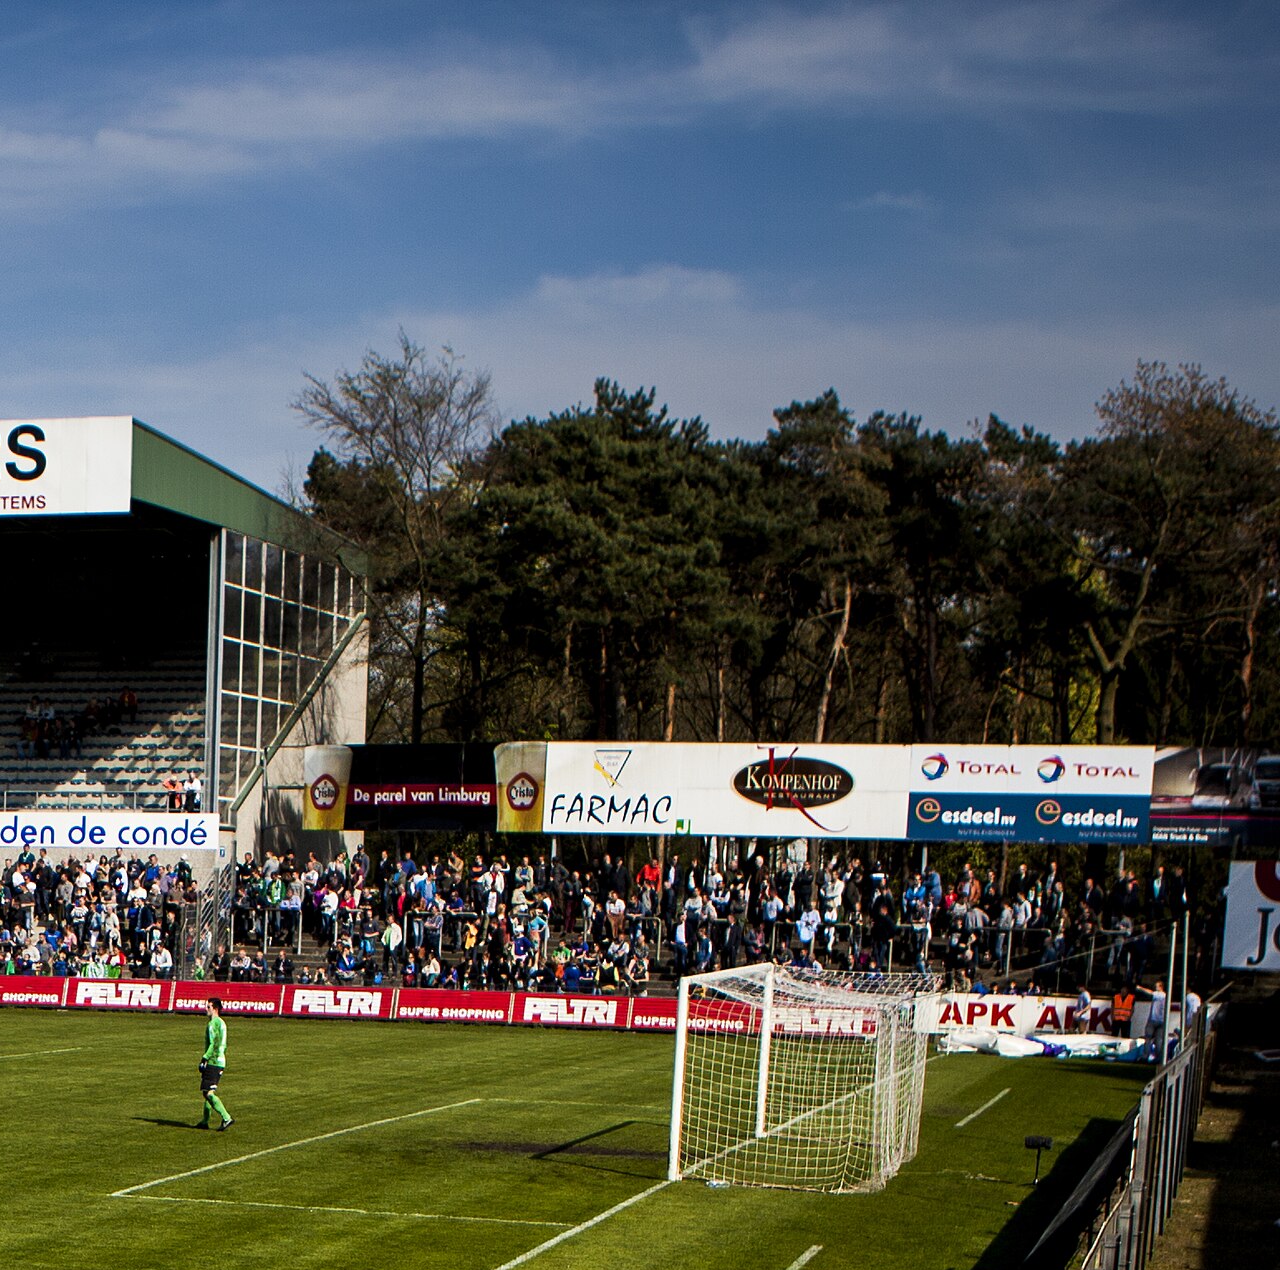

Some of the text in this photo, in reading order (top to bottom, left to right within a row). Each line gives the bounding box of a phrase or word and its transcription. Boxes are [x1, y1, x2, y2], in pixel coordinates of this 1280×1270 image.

[745, 765, 842, 790] KOMPENHOF
[956, 761, 1022, 775] TOTAL
[1073, 763, 1140, 778] TOTAL
[354, 787, 491, 804] De parel van Limburg
[550, 792, 672, 825] FARMAC
[941, 807, 1017, 826] esdeel nv
[1061, 809, 1139, 828] esdeel nv
[68, 815, 107, 844] de
[118, 819, 208, 846] condé
[3, 993, 59, 1003] SHOPPING
[76, 982, 162, 1007] PELTRI
[292, 989, 383, 1016] PELTRI
[176, 998, 275, 1012] SUPE HOPPING
[399, 1006, 505, 1020] SUPER SHOPPING
[523, 997, 618, 1024] PELTRI
[939, 1001, 1016, 1027] APK
[634, 1015, 744, 1030] SUPER HOPPING
